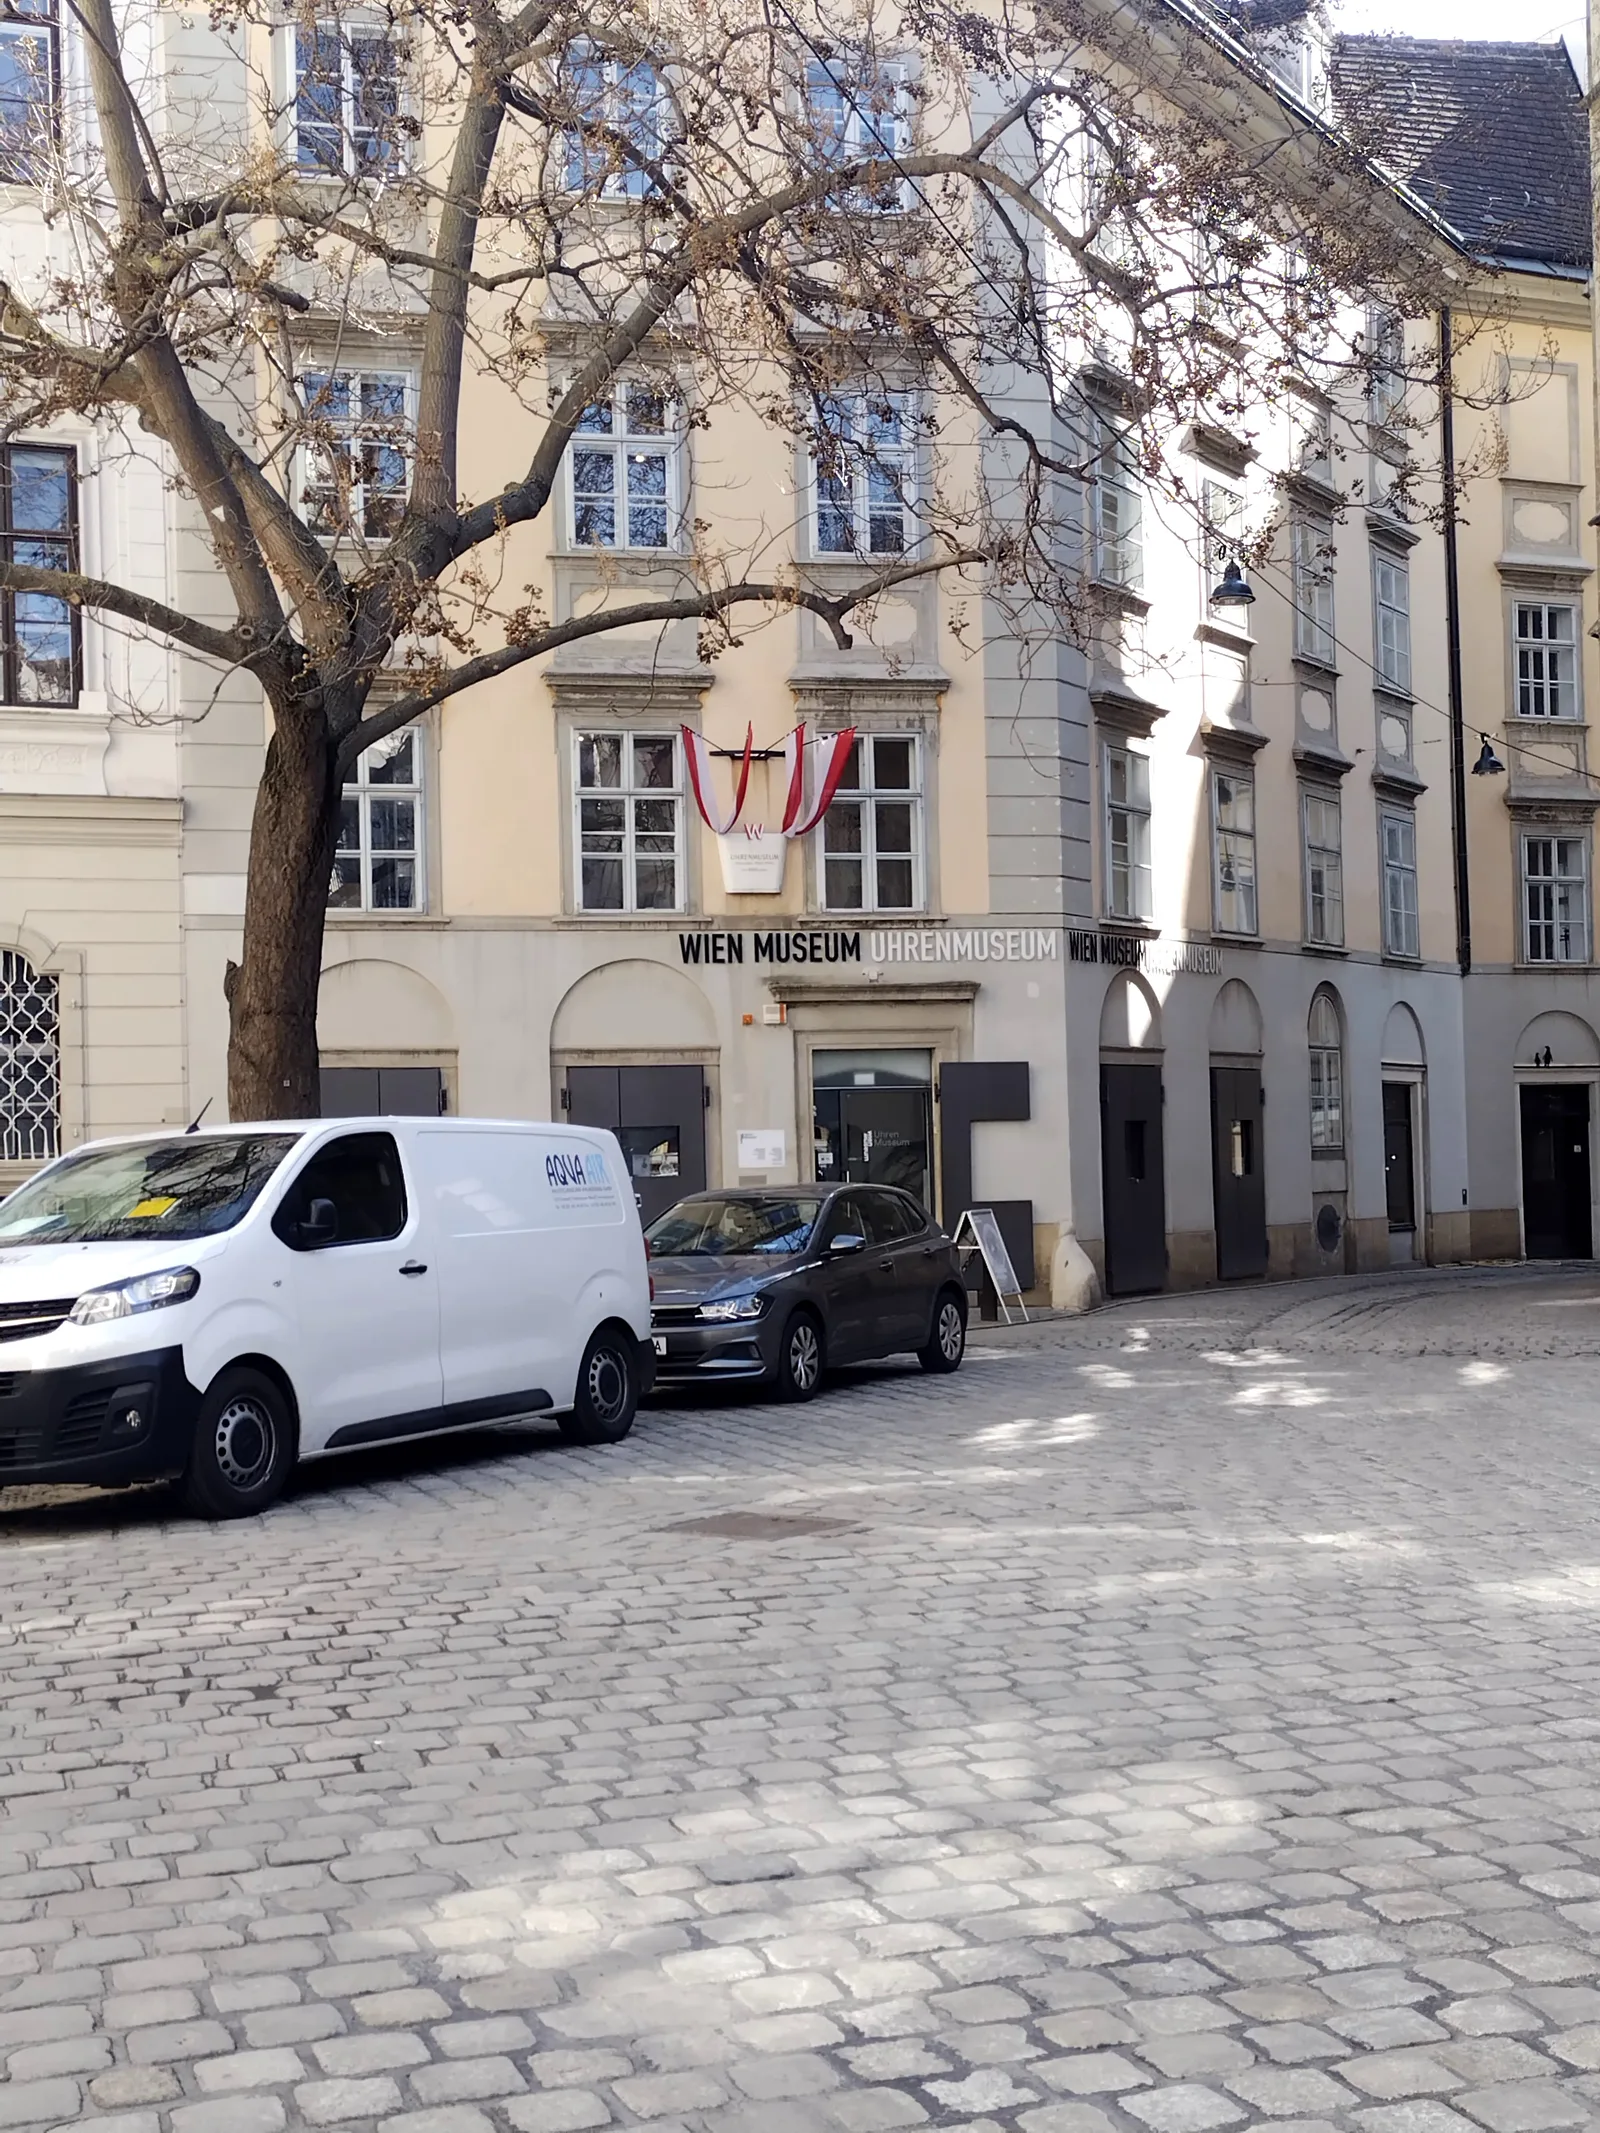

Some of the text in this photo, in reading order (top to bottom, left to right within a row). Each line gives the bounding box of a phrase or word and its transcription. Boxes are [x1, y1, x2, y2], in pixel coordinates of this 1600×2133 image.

[679, 930, 1057, 964] WIEN MUSEUM UHRENMUSEUM
[1069, 931, 1223, 974] WIEN MUSEUM UNMUSEUM
[873, 1130, 900, 1139] Uhren
[873, 1139, 911, 1147] Museum
[586, 1153, 611, 1184] AIR
